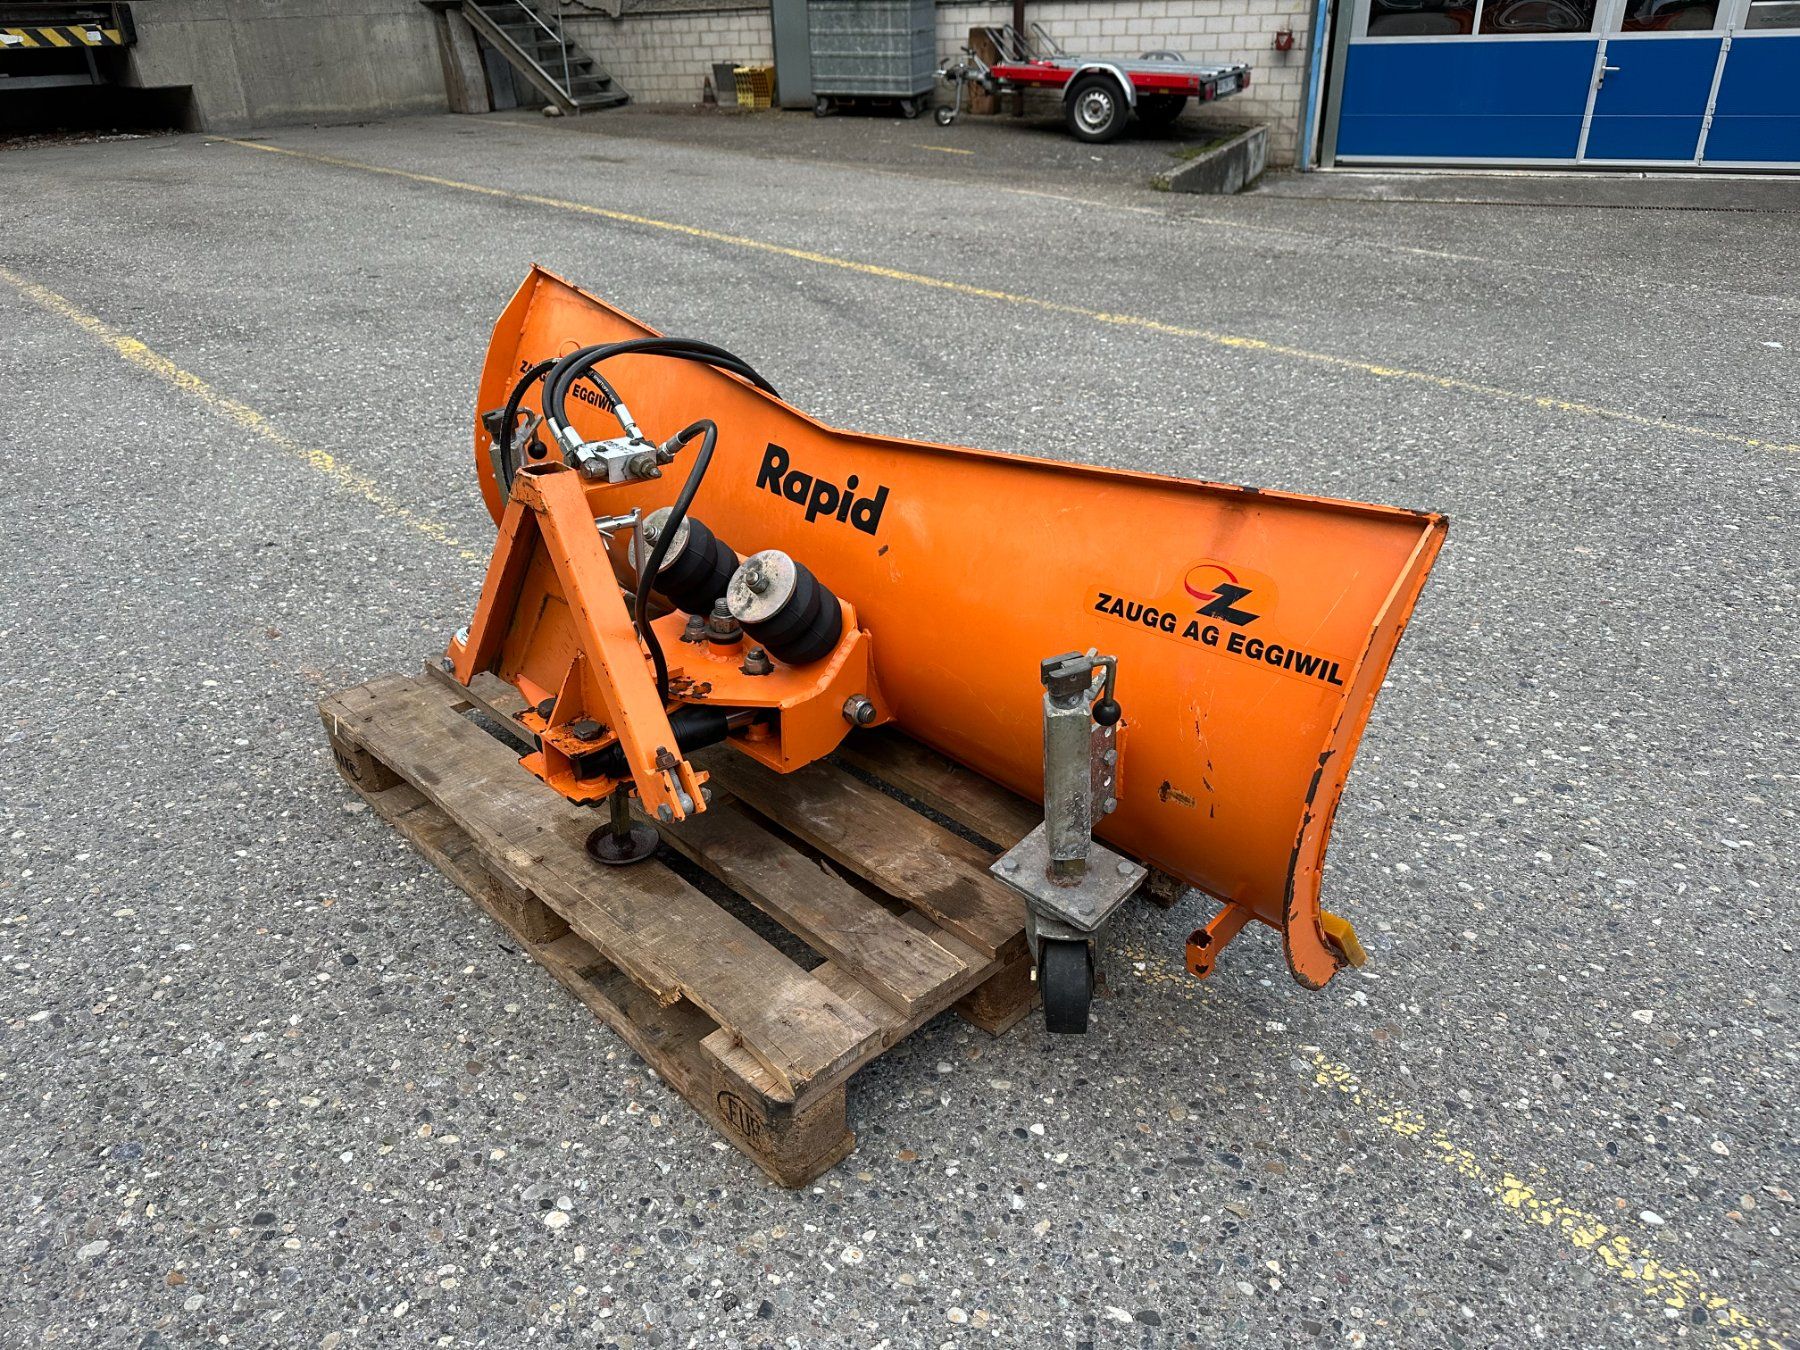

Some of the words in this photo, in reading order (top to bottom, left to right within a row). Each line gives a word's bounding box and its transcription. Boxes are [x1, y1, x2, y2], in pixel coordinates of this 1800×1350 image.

[756, 442, 890, 536] Rapid
[1094, 593, 1177, 634] ZAUGG
[1182, 620, 1220, 647] AG
[1226, 632, 1344, 687] EGGIWIL
